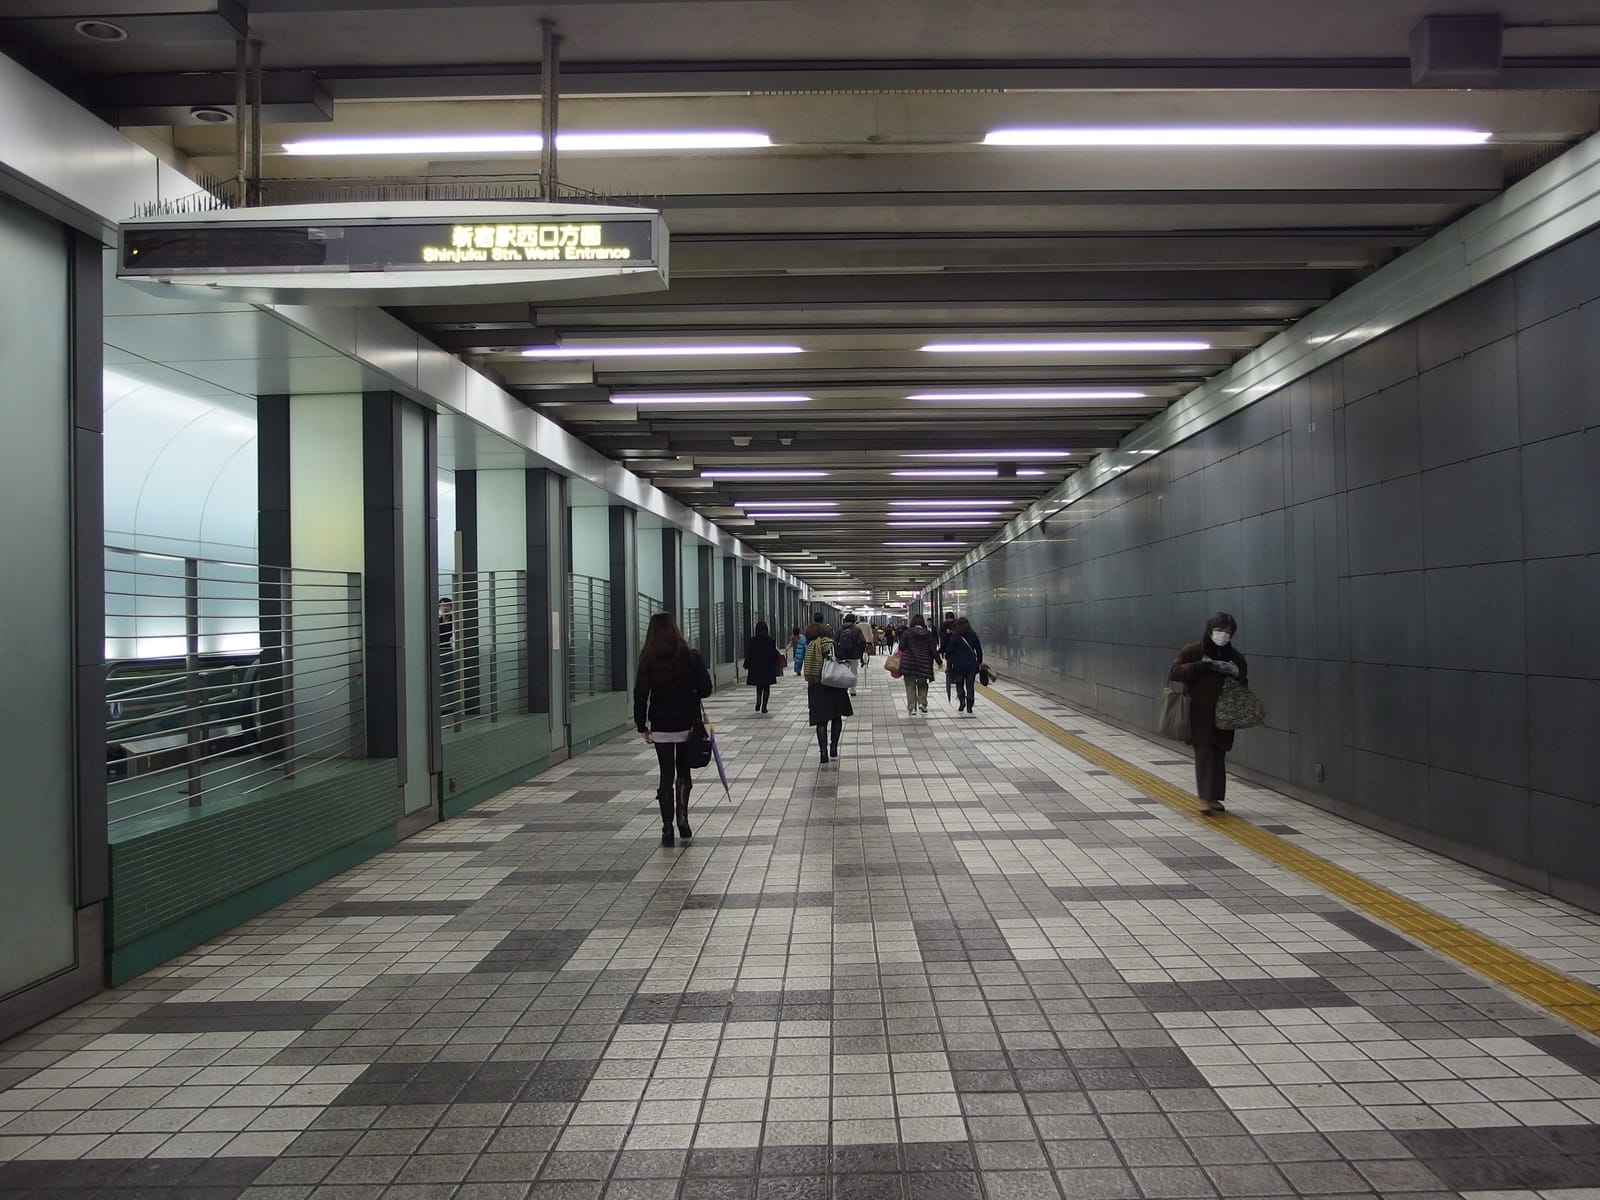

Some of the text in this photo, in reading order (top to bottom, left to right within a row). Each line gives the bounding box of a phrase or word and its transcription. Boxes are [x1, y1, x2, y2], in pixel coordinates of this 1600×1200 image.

[452, 225, 601, 248] 新宿駅西口方面
[423, 246, 630, 263] Shinjuku Stn. West Entrance
